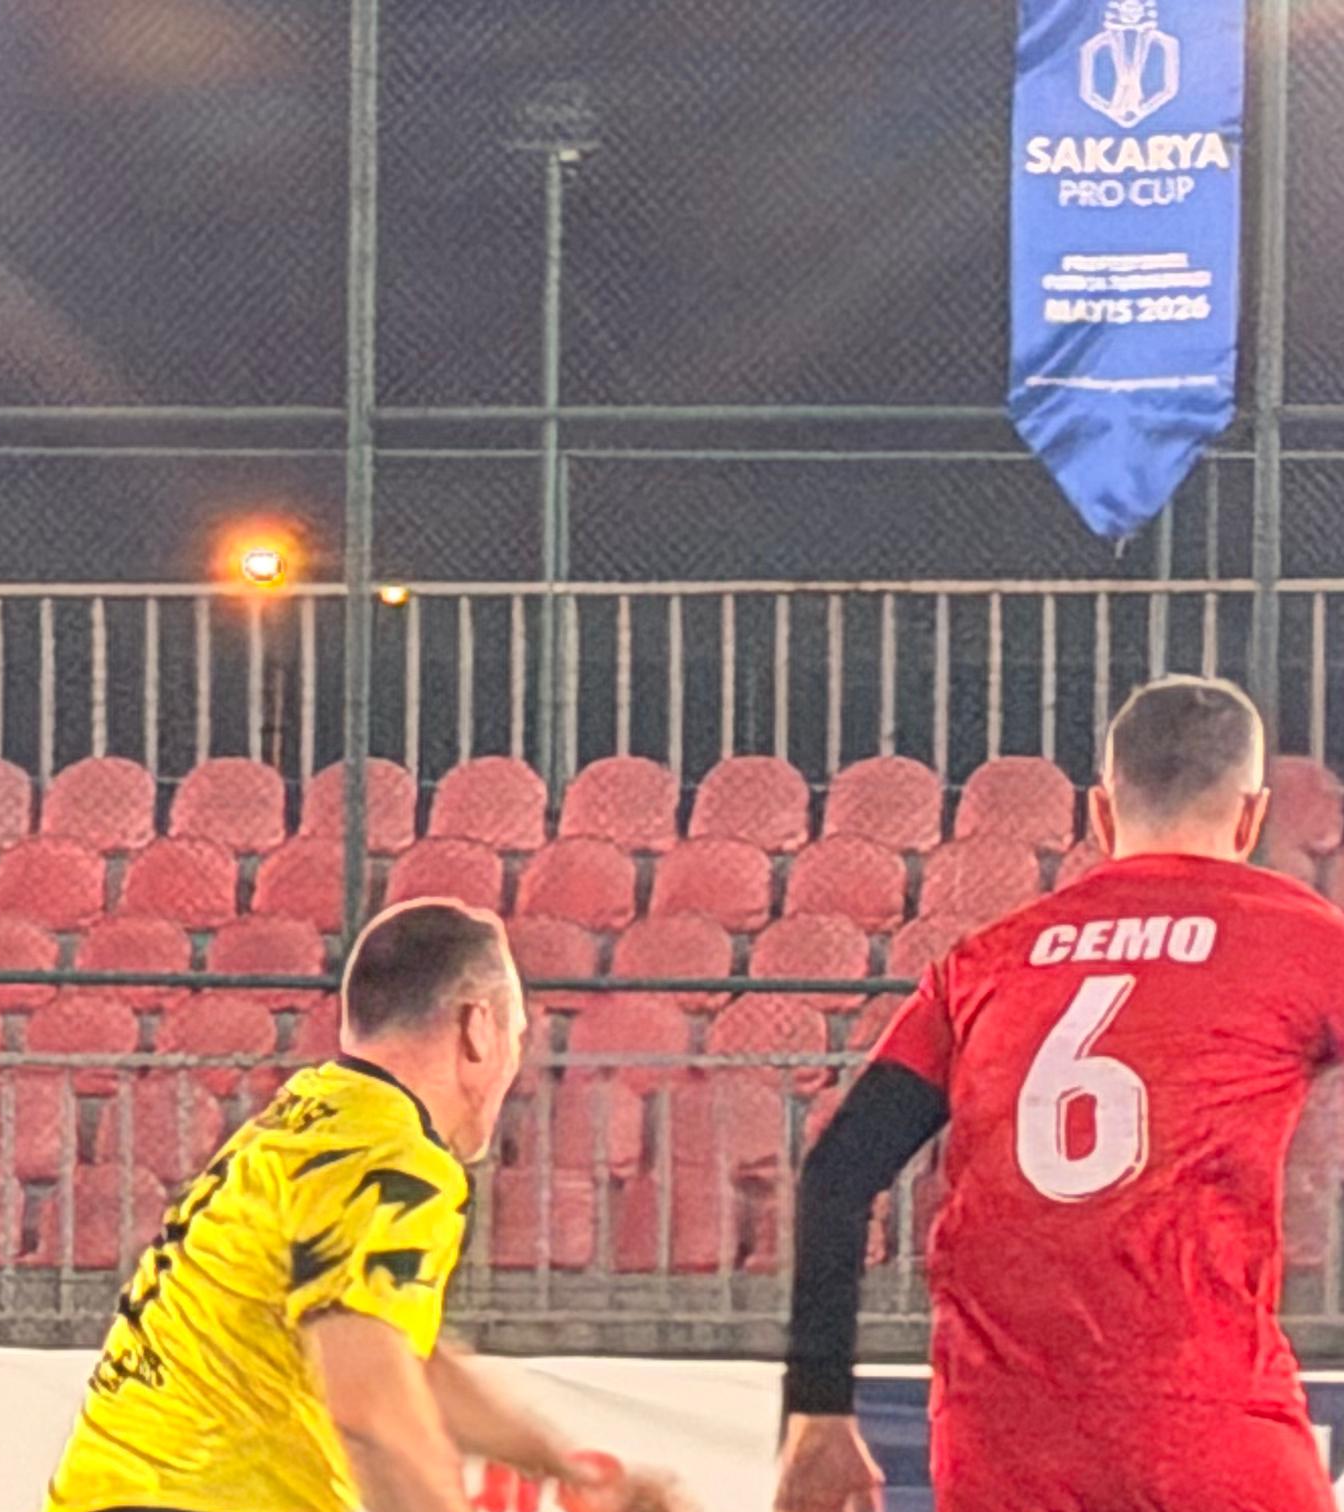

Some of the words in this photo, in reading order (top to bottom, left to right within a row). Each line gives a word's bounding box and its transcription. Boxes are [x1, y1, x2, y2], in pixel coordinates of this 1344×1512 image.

[1025, 132, 1230, 174] SAKARYA
[1059, 178, 1125, 207] PRO
[1129, 175, 1195, 207] CUP
[1136, 295, 1211, 322] 2026
[1029, 916, 1217, 966] CEMO
[1017, 974, 1149, 1203] 6
